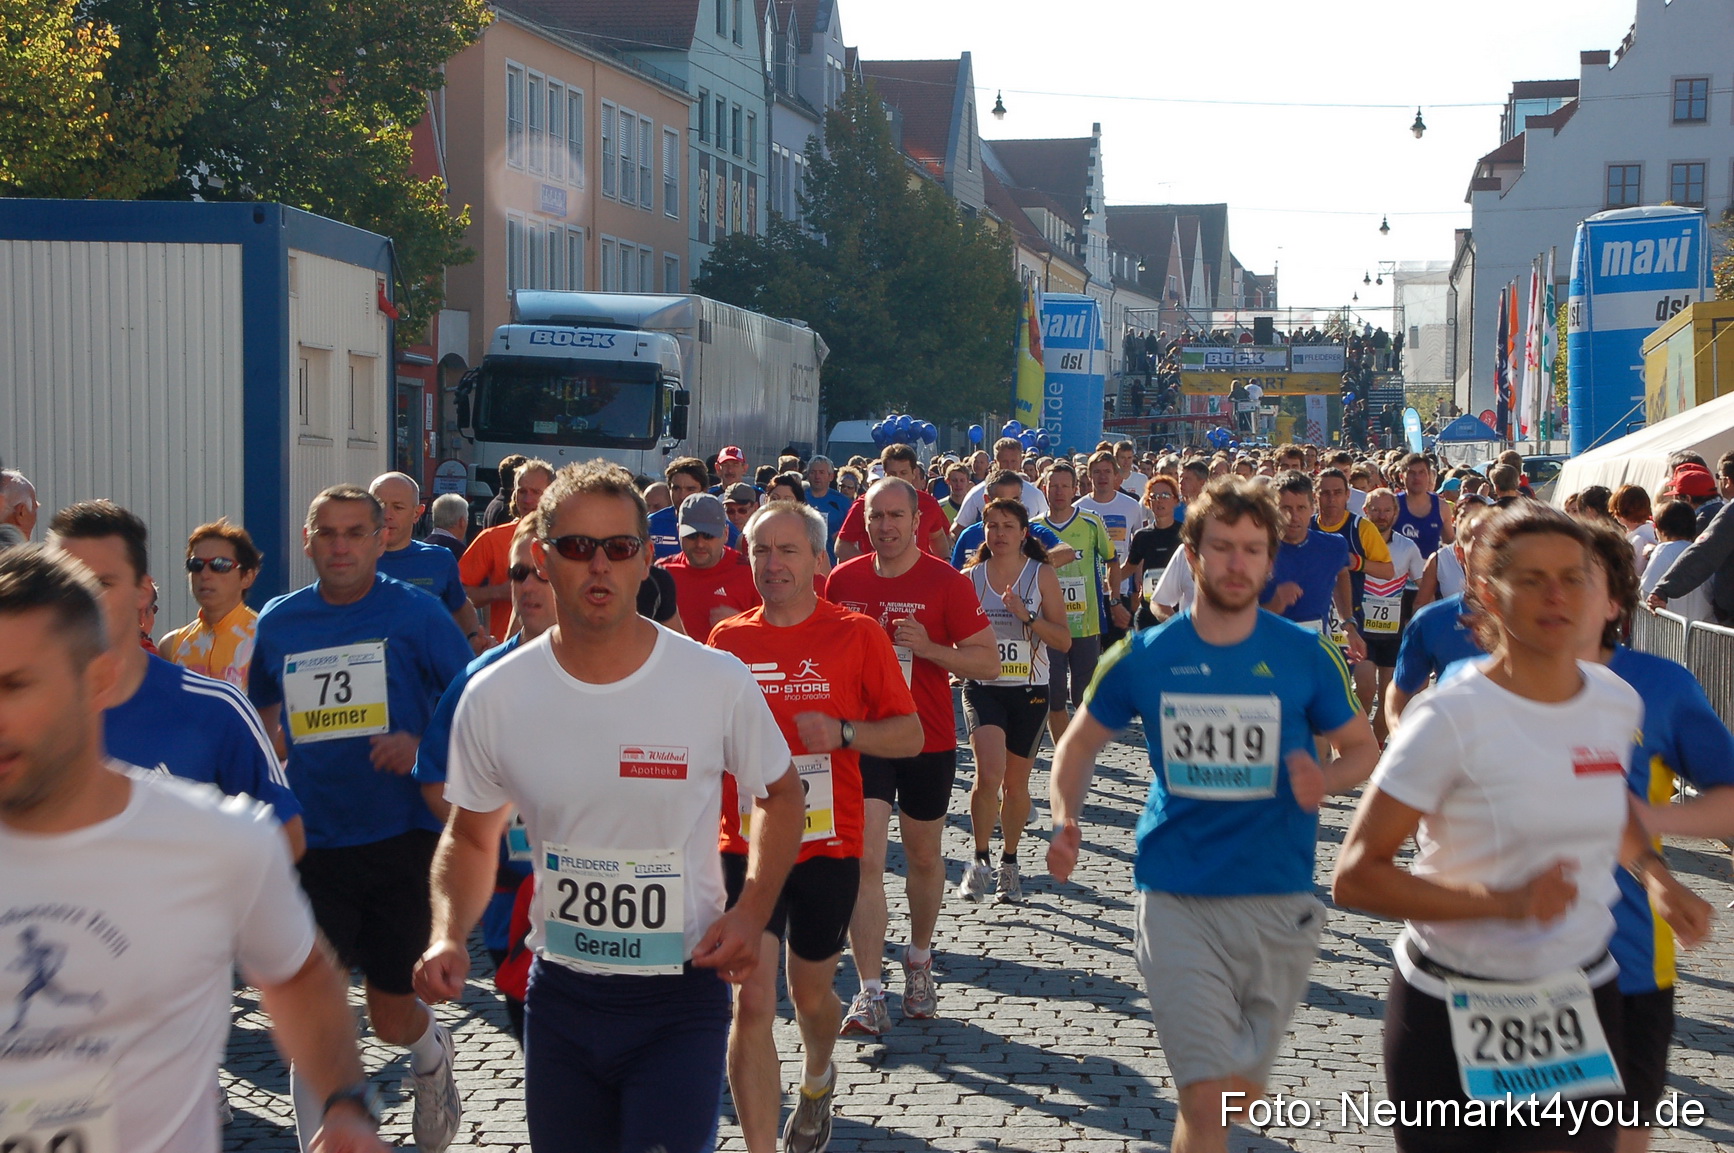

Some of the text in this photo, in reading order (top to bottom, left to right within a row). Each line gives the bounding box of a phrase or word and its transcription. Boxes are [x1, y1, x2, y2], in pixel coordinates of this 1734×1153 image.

[1600, 229, 1692, 277] maxi
[530, 330, 616, 348] BOCK
[1061, 353, 1083, 370] dsl
[1205, 352, 1265, 364] BOCK
[1304, 353, 1342, 361] PFLEIDERER
[888, 602, 925, 610] NEUMARKTER
[1066, 602, 1082, 610] rich
[1373, 606, 1389, 620] 78
[1365, 619, 1391, 629] Roland
[1000, 664, 1028, 674] marie
[313, 670, 353, 707] 73
[802, 692, 830, 700] creation
[305, 708, 367, 729] Werner
[1173, 722, 1265, 762] 3419
[648, 750, 686, 761] Wildbad
[631, 765, 678, 776] Apotheke
[561, 855, 620, 872] PFLEIDERER
[557, 878, 666, 929] 2860
[575, 932, 641, 958] Gerald
[1469, 1002, 1586, 1064] 2859
[1492, 1062, 1586, 1094] Andrea
